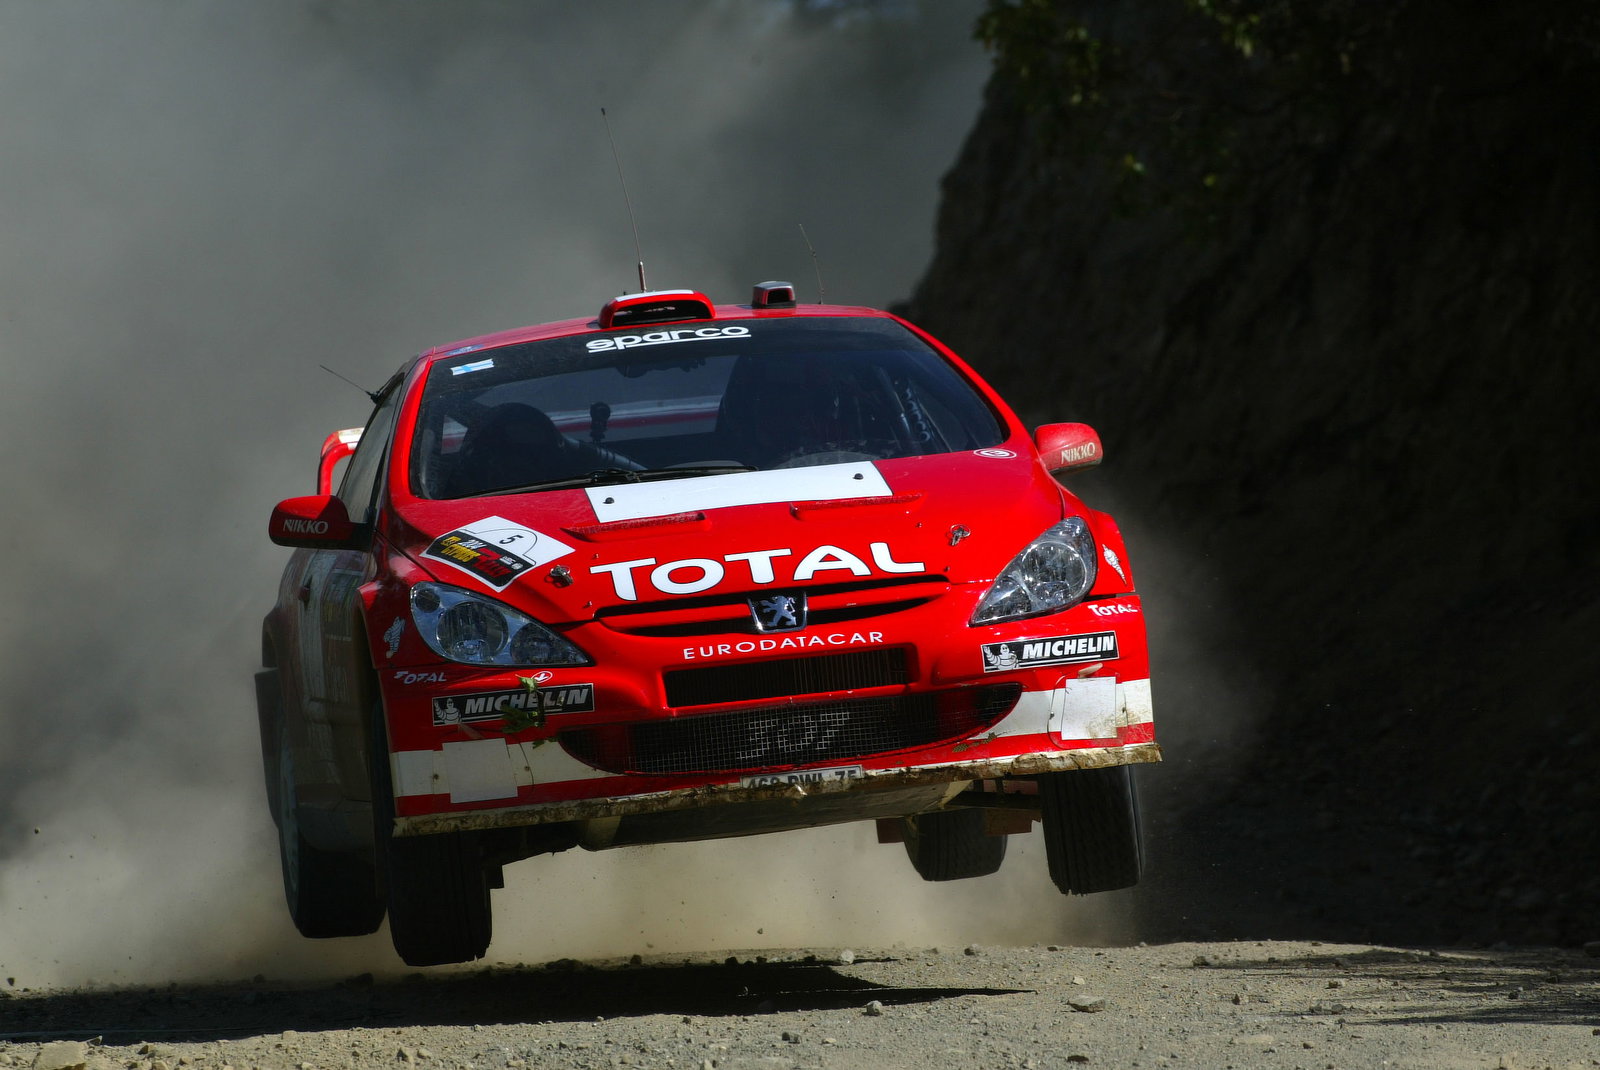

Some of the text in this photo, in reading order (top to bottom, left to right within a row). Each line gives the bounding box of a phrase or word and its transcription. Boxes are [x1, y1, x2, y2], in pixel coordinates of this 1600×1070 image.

[586, 326, 750, 352] sparco
[1061, 442, 1096, 464] NIKKO
[283, 519, 329, 534] NIKKO
[499, 534, 524, 545] 5
[590, 542, 926, 601] TOTAL
[1088, 604, 1138, 616] TOTAL
[684, 631, 884, 660] EURODATACAR
[1022, 635, 1114, 659] MICHELIN
[394, 671, 447, 685] TOTAL
[465, 688, 589, 714] MICHELIN
